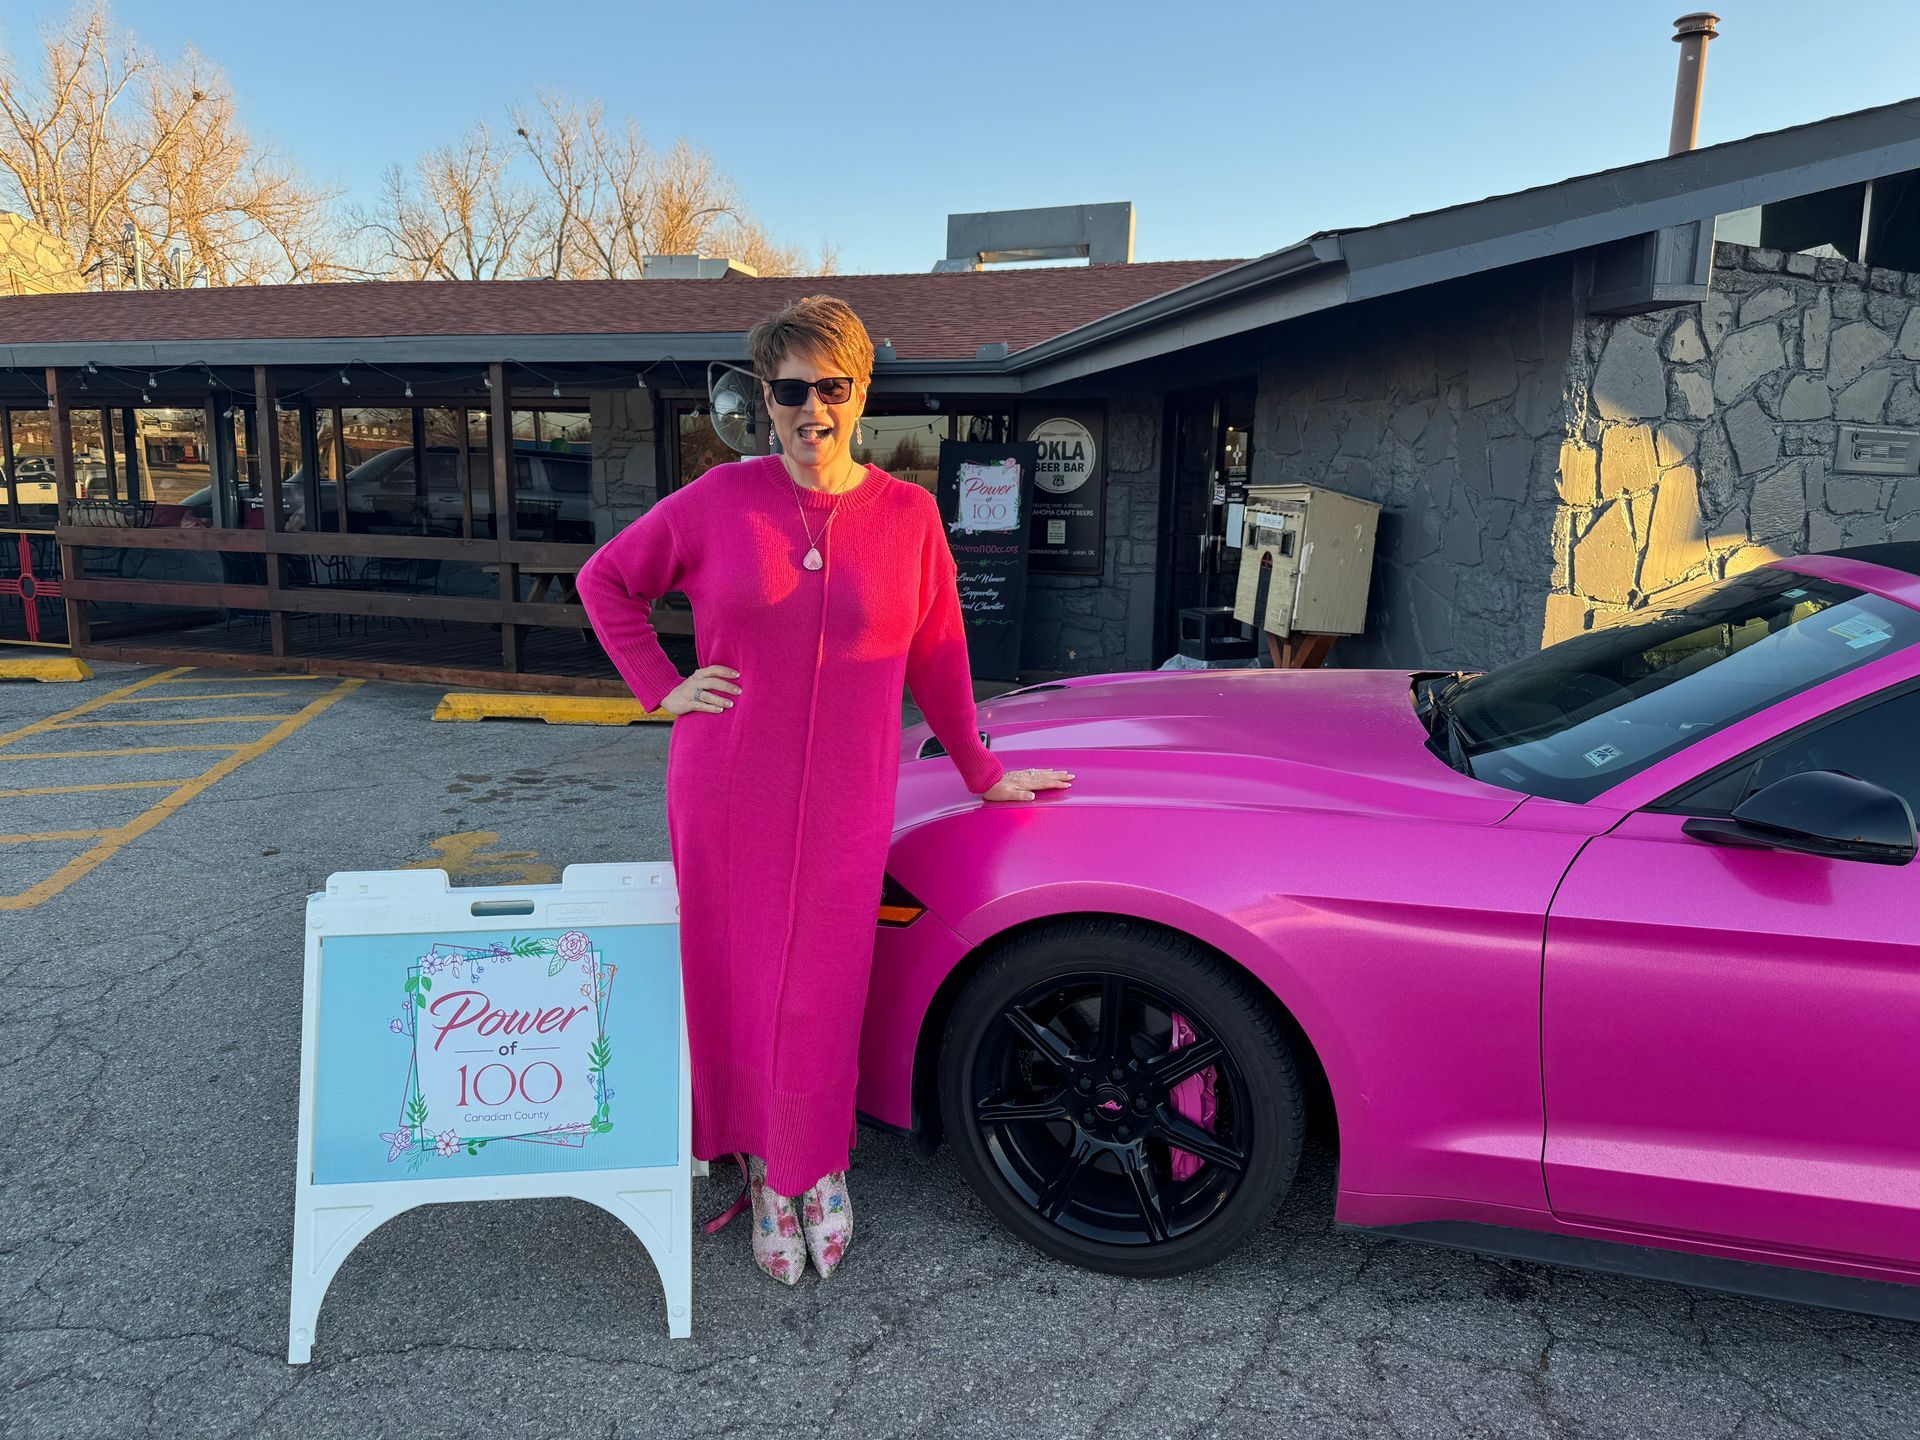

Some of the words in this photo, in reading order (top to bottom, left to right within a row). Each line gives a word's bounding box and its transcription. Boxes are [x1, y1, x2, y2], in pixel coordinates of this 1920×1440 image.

[1035, 441, 1084, 460] OKLA
[1035, 463, 1060, 472] BEER
[1064, 463, 1084, 472] BAR
[964, 477, 1015, 498] Power
[973, 504, 1006, 519] 100
[957, 572, 979, 582] Local
[978, 572, 1006, 583] Women
[959, 586, 999, 600] Supporting
[974, 601, 1005, 611] Charities
[430, 990, 588, 1052] Power
[499, 1041, 518, 1056] of
[456, 1061, 562, 1106] 100
[464, 1113, 511, 1123] Canadian
[514, 1111, 549, 1122] County
